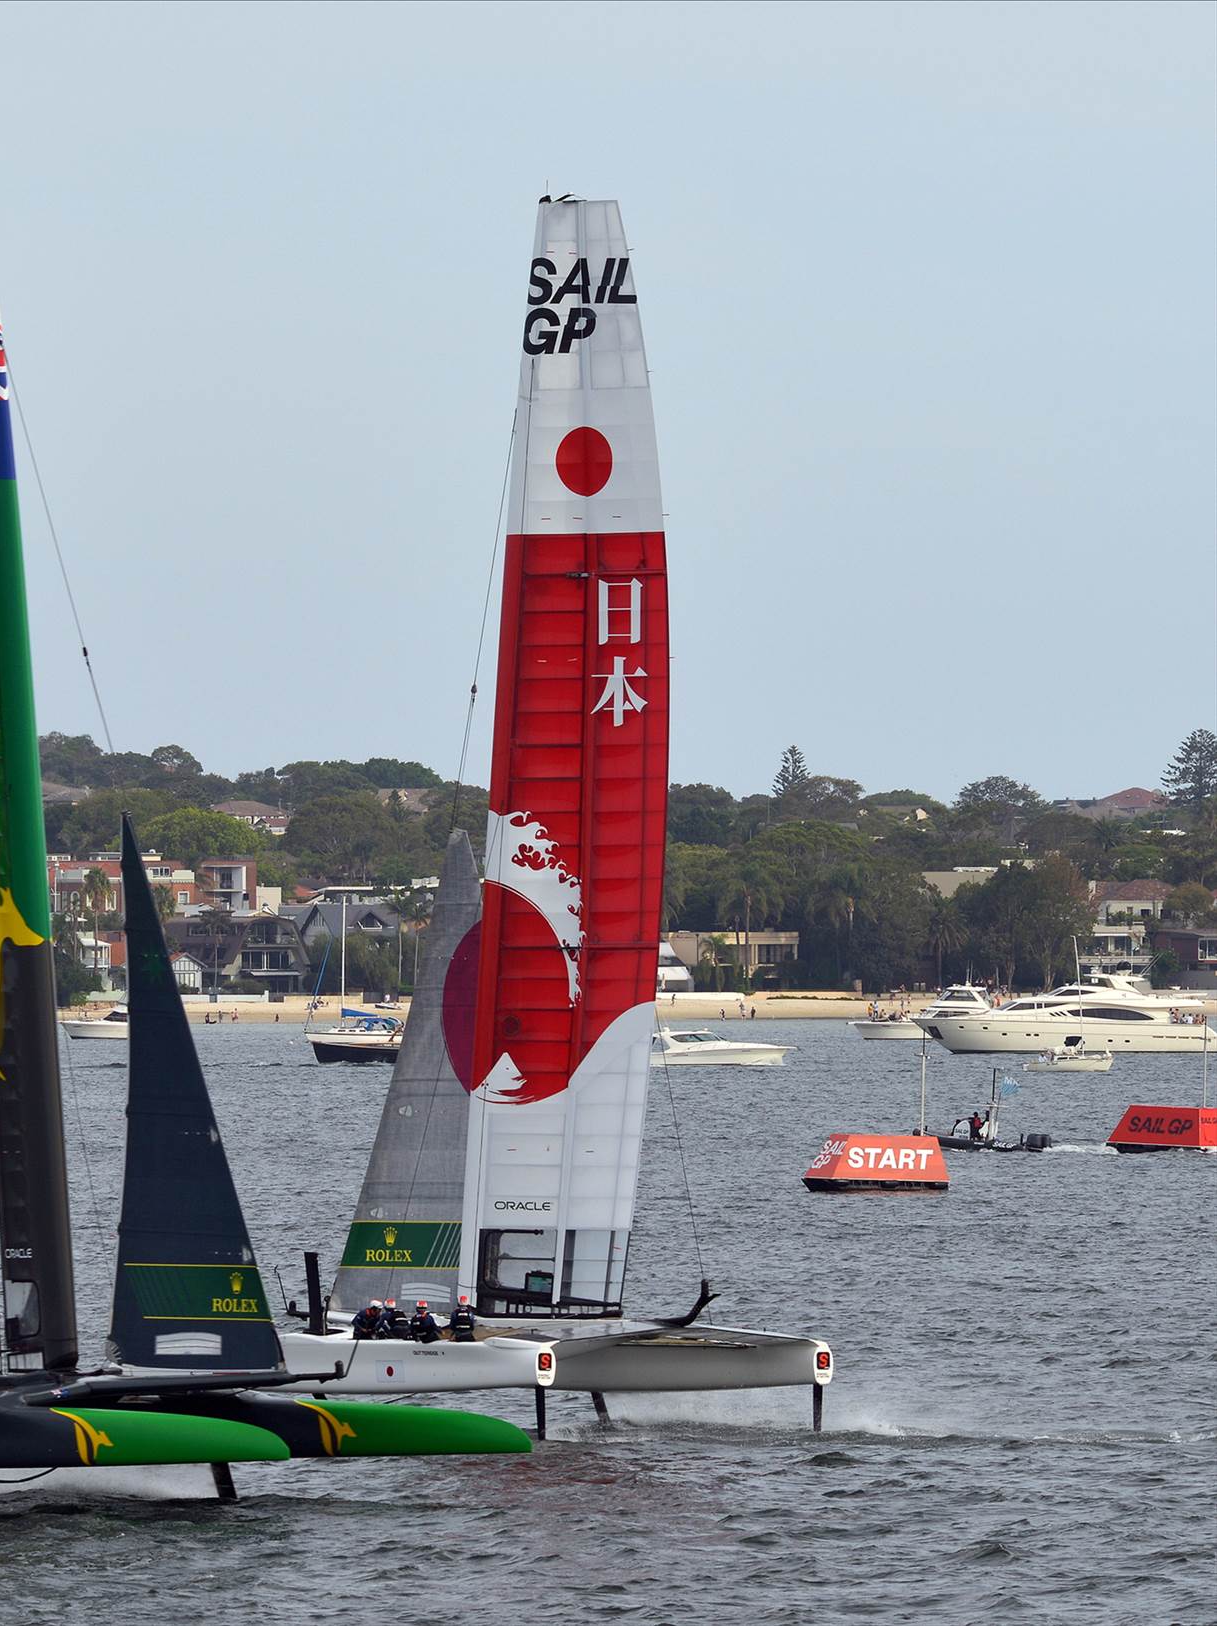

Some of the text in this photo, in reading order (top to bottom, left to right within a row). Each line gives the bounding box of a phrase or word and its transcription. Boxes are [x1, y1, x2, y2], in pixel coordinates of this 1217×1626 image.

[527, 257, 637, 305] SAIL
[523, 307, 597, 355] GP
[590, 577, 649, 727] 日本
[1128, 1116, 1193, 1135] SAIL GP
[820, 1140, 848, 1156] SAIL
[812, 1155, 831, 1169] GP
[847, 1147, 934, 1170] START
[494, 1201, 551, 1211] ORACLE
[5, 1248, 33, 1259] ORACLE
[365, 1249, 413, 1263] ROLEX
[211, 1297, 258, 1313] ROLEX
